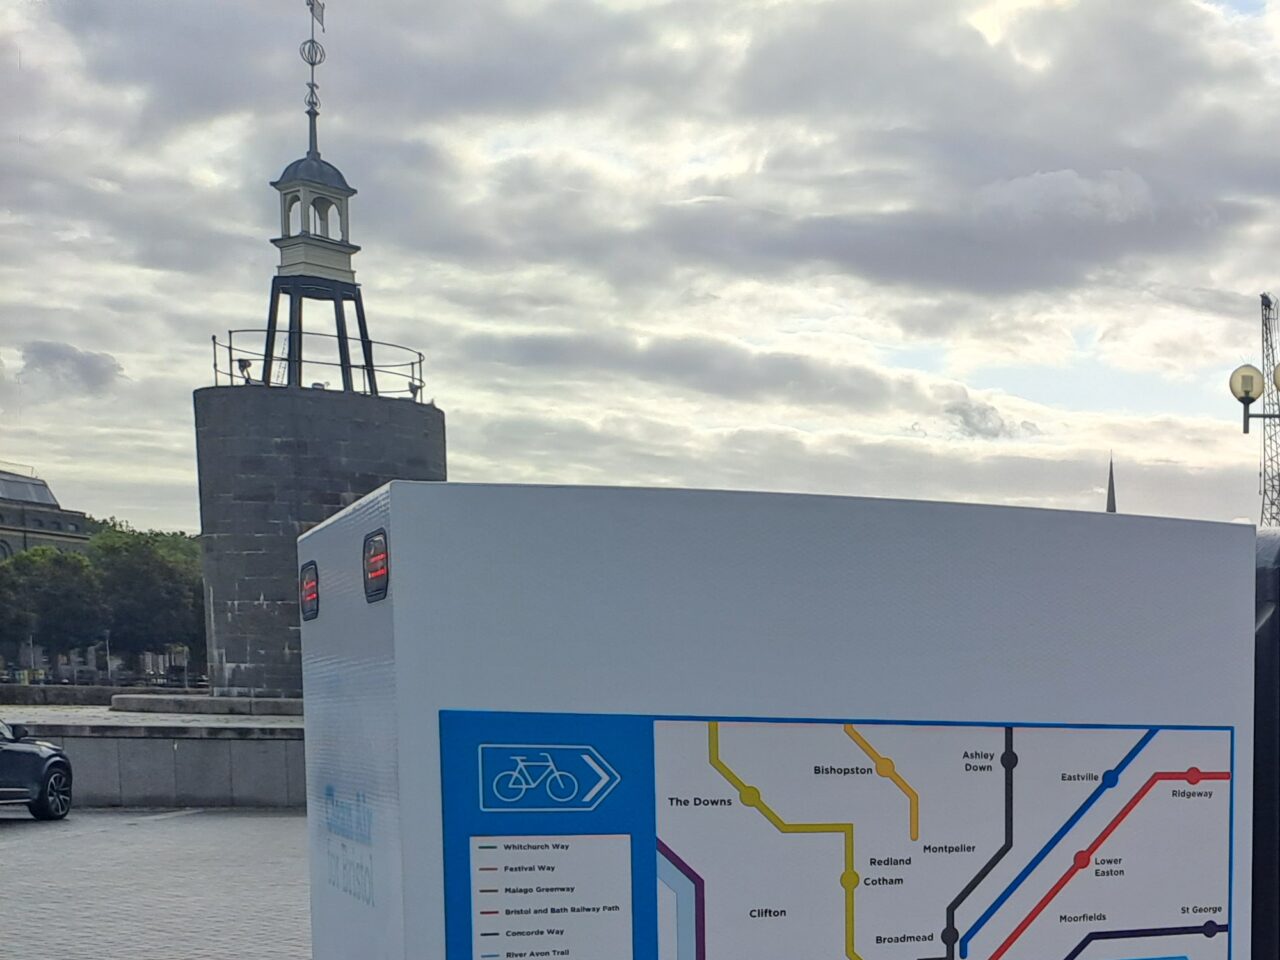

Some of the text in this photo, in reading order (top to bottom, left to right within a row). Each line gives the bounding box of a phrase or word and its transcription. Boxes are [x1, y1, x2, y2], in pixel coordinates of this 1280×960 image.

[962, 751, 995, 762] Ashley
[813, 765, 873, 776] Bishopston
[965, 763, 993, 772] Down
[1061, 772, 1099, 782] Eastville
[1171, 789, 1213, 799] Ridgeway
[668, 797, 732, 807] The Downs
[503, 843, 570, 851] Whitchurch Way
[923, 844, 976, 855] Montpelier
[869, 856, 912, 866] Redland
[1094, 857, 1122, 866] Lower
[504, 865, 555, 873] Festival Way
[1094, 868, 1125, 877] Easton
[863, 877, 904, 886] Cotham
[504, 886, 575, 895] Malago Greenway
[533, 907, 548, 915] and
[551, 906, 568, 914] Bath
[570, 906, 600, 914] Railway
[749, 908, 787, 918] Clifton
[1181, 905, 1222, 915] St George
[1059, 912, 1107, 923] Moorfields
[505, 928, 564, 937] Concorde Way
[875, 933, 934, 944] Broadmead
[506, 951, 527, 959] River
[552, 949, 569, 957] Trail
